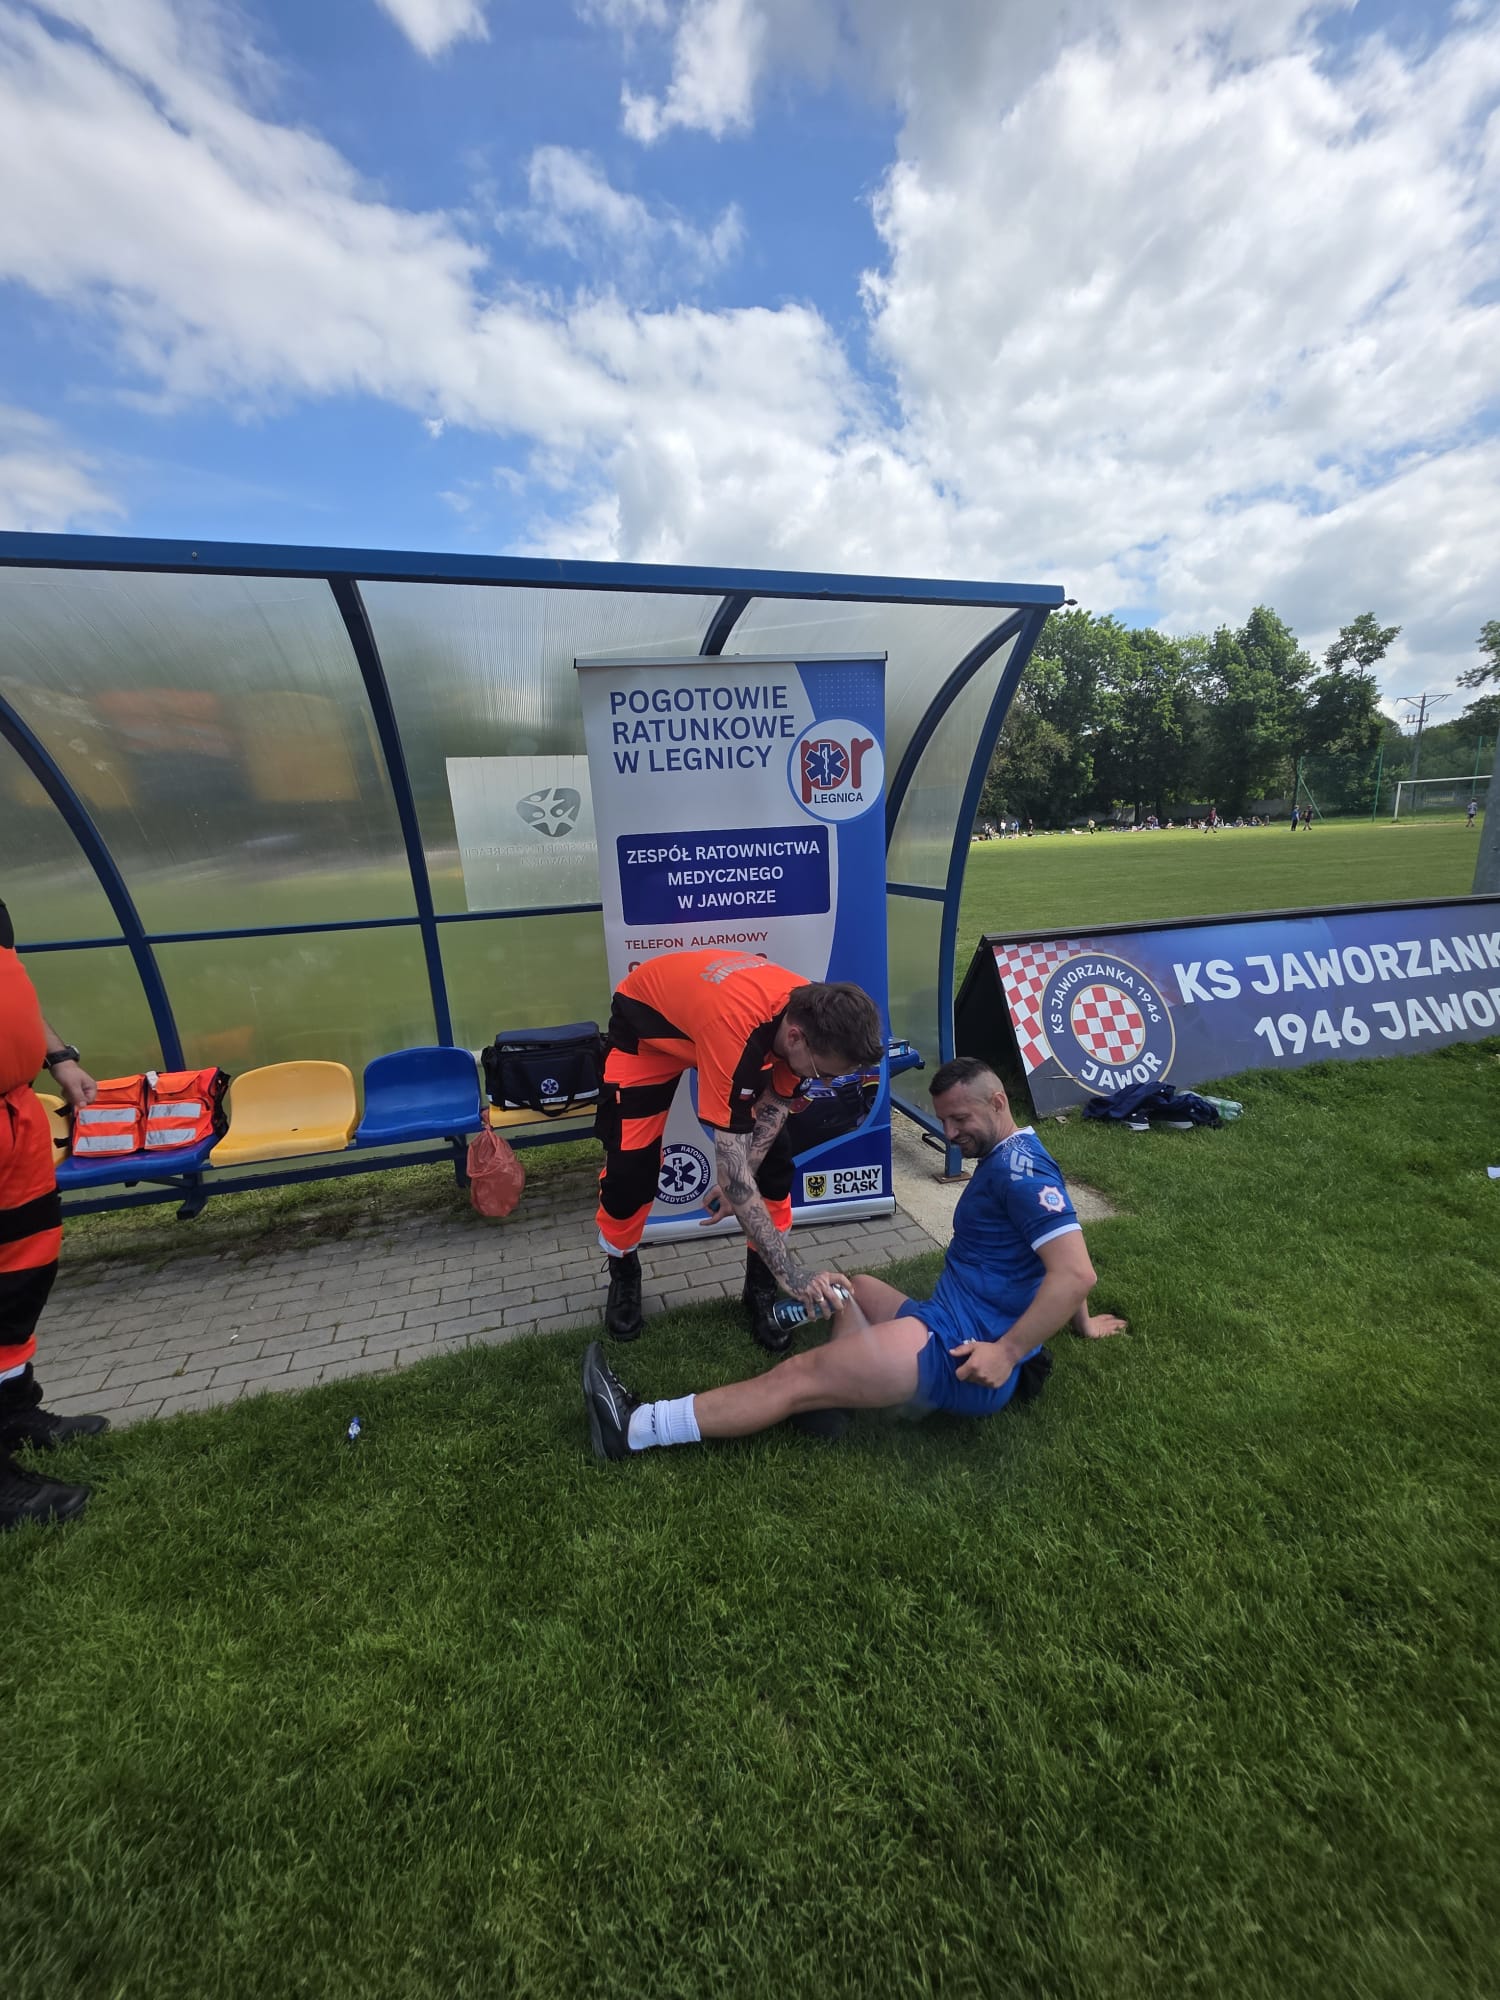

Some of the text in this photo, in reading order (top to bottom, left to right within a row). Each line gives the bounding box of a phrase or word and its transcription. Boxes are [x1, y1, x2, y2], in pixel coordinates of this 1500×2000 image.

[610, 685, 788, 716] POGOTOWIE
[612, 714, 796, 745] RATUNKOWE
[613, 745, 772, 774] W LEGNICY
[814, 792, 864, 804] LEGNICA
[626, 840, 821, 865] ZESPÓŁ RATOWNICTWA
[667, 866, 784, 887] MEDYCZNEGO
[677, 889, 777, 909] W JAWORZE
[625, 931, 769, 950] TELEFON ALARMOWY
[1173, 959, 1241, 1004] KS
[1050, 964, 1162, 1034] KS JAWORZANKA 1946
[1254, 1006, 1371, 1057] 1946
[1081, 1051, 1163, 1090] JAWOR
[680, 1145, 709, 1184] RATOWNICTWO
[833, 1168, 881, 1183] DOLNY
[658, 1189, 701, 1203] MEDYCZNE
